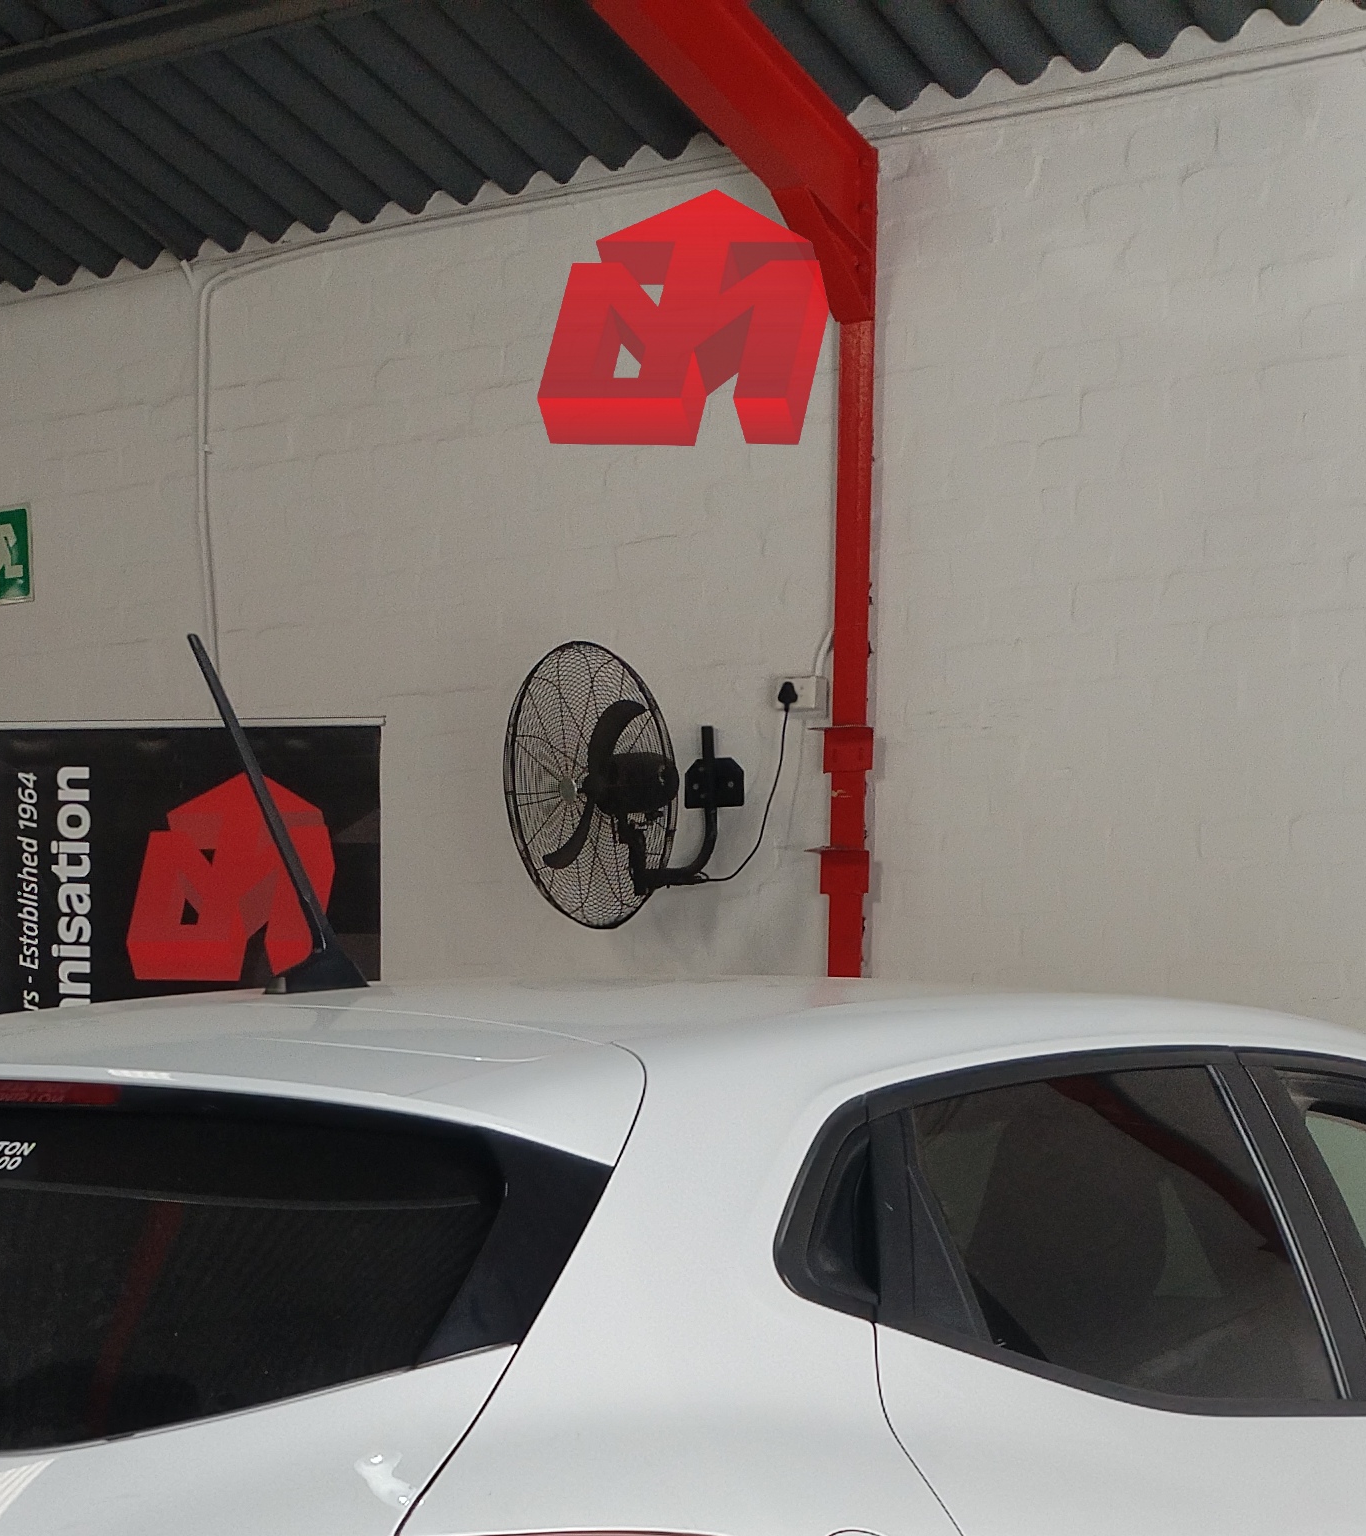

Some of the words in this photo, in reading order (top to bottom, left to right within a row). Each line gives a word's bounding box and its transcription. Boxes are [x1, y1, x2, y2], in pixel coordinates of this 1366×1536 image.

[17, 771, 39, 830] 1964
[16, 835, 40, 970] Established
[50, 765, 93, 1008] nisation
